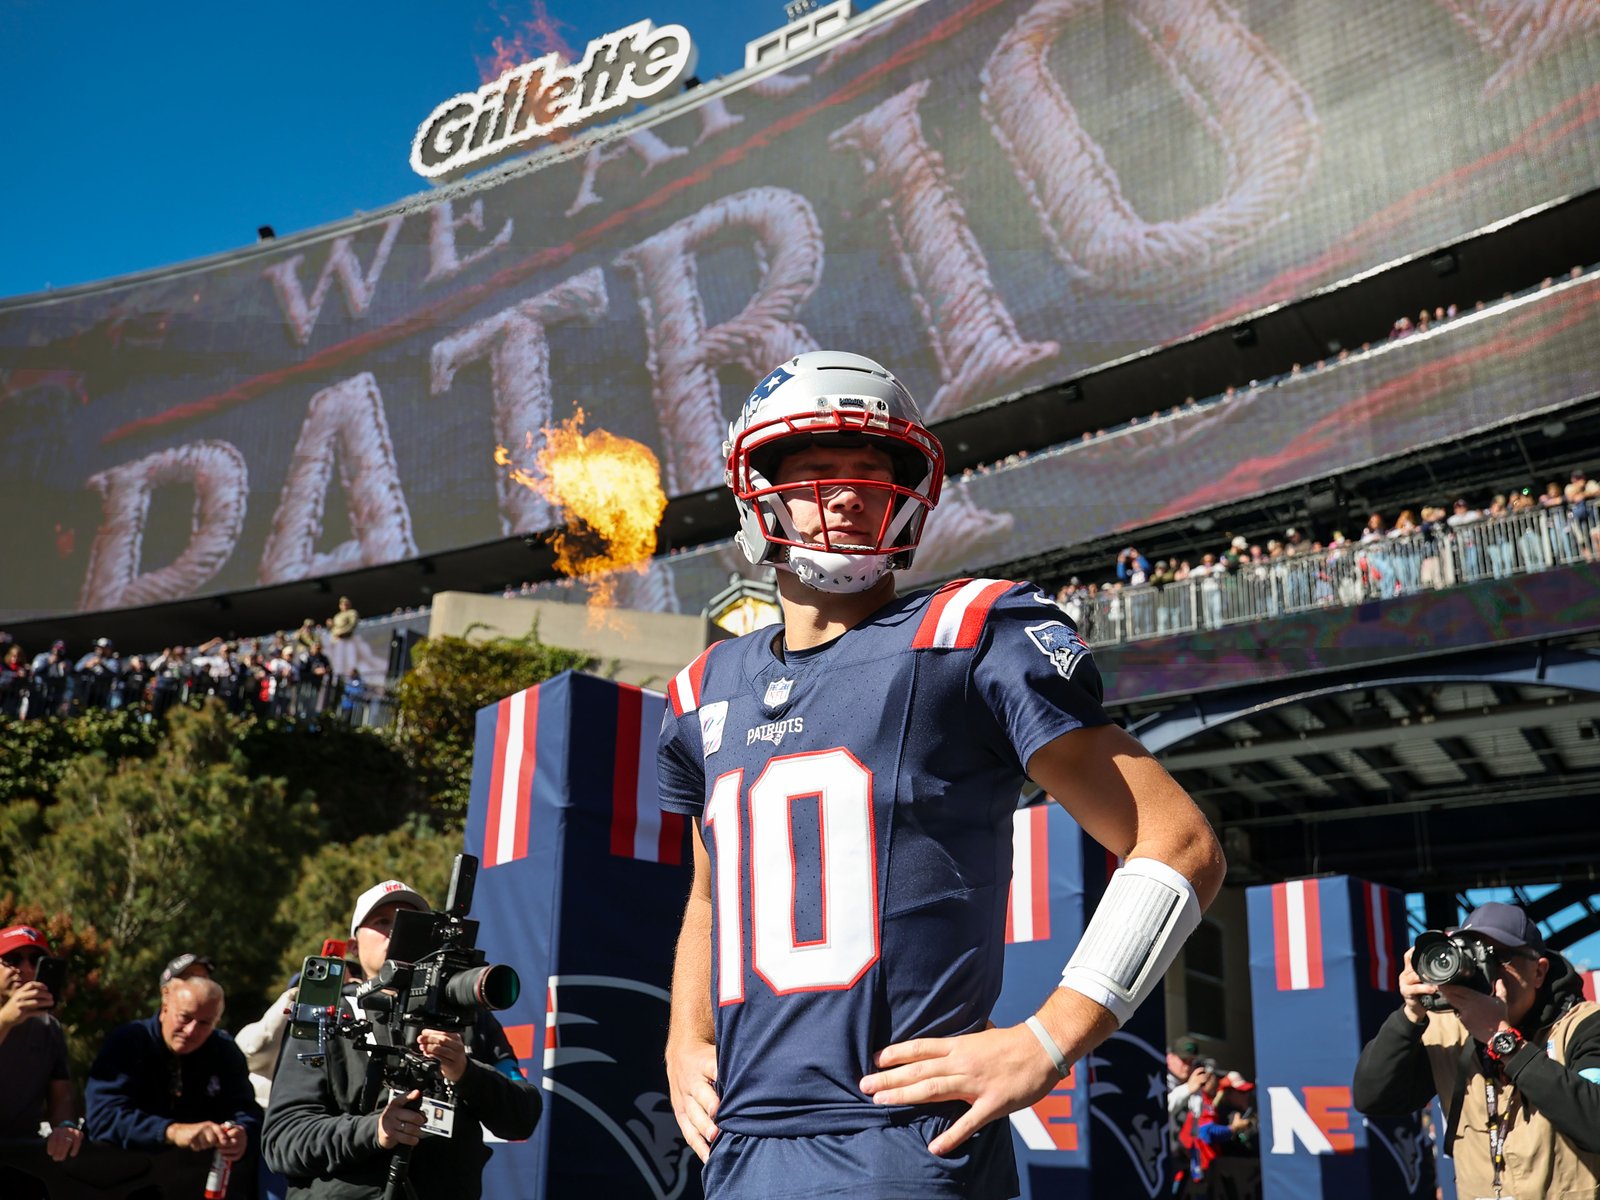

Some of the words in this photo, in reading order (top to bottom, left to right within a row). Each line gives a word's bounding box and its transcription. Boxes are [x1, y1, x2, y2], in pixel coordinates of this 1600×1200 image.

[415, 28, 687, 171] Gillette
[263, 198, 515, 346] WE
[747, 717, 804, 746] PATRIOTS
[705, 746, 880, 1008] 10
[1266, 1086, 1355, 1155] NE
